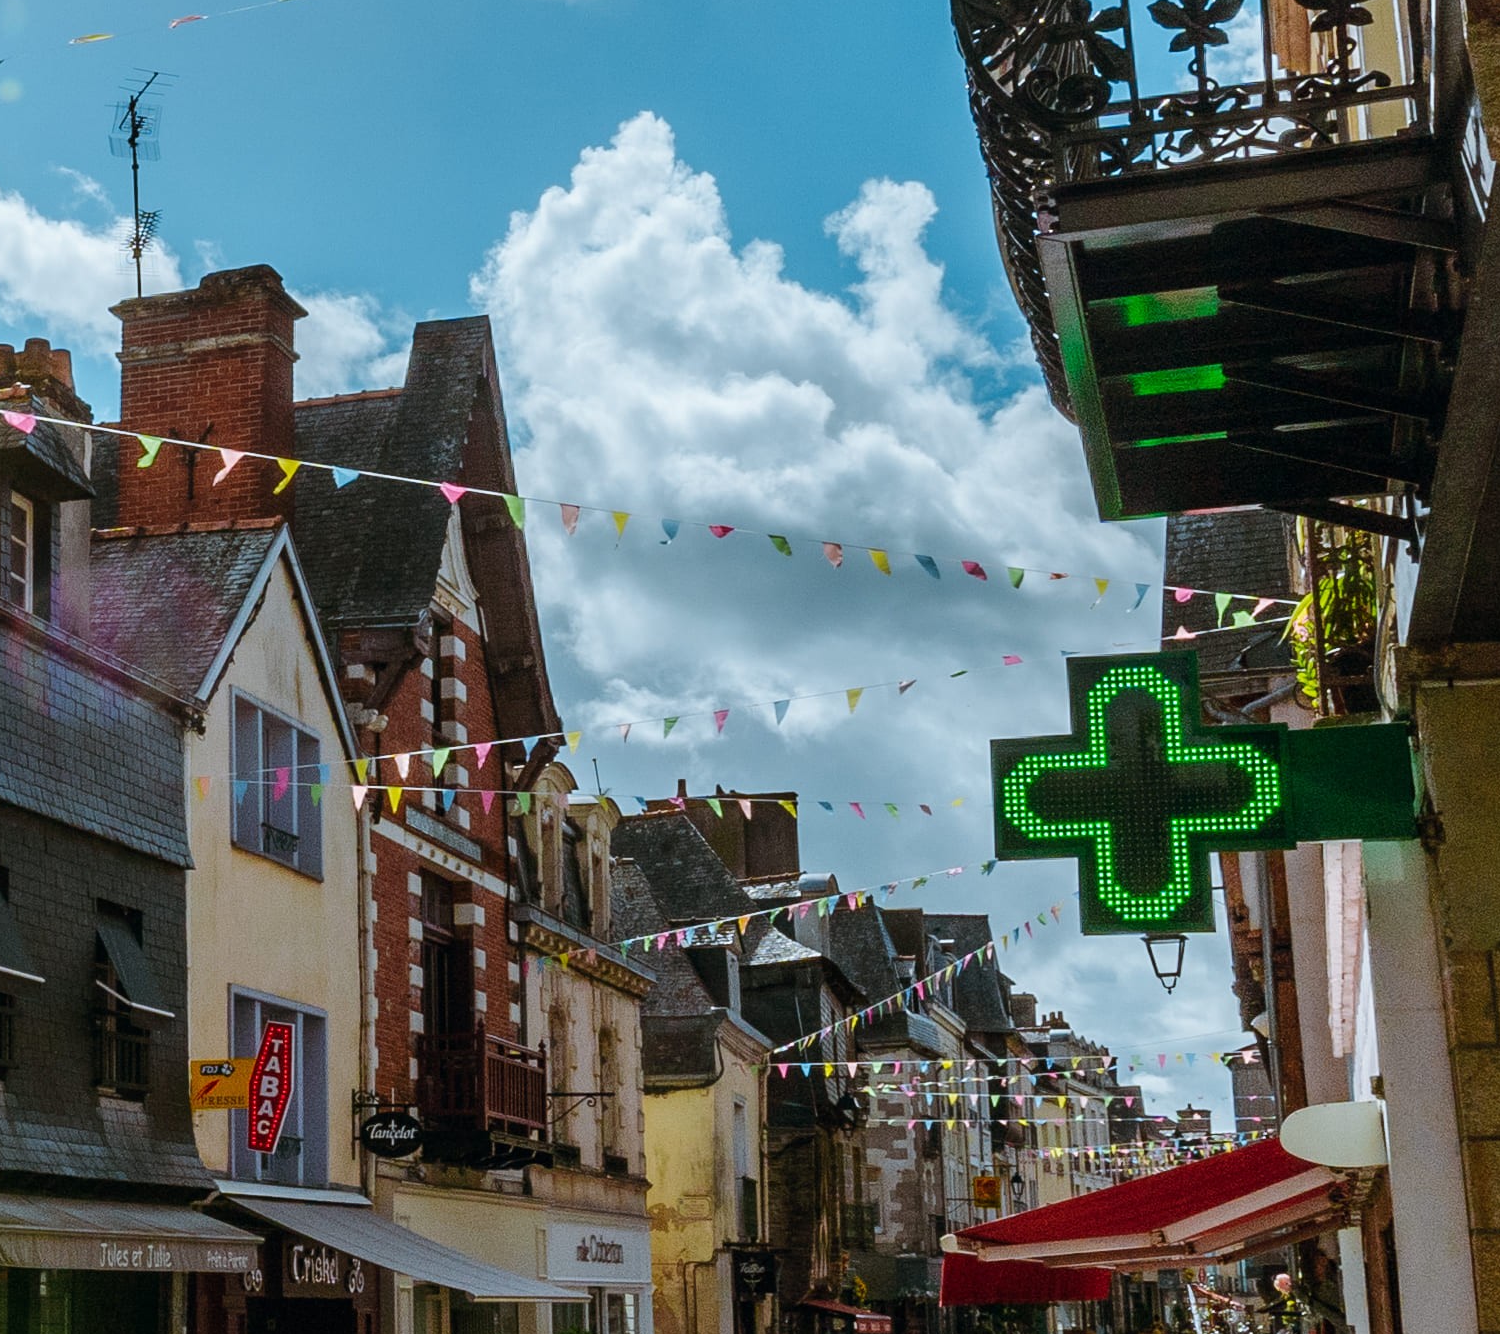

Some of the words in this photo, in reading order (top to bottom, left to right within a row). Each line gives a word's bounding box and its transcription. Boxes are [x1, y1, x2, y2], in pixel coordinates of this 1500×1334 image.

[201, 1065, 219, 1075] FDJ
[256, 1038, 284, 1136] TABAC
[201, 1095, 246, 1106] PRESSE
[100, 1242, 129, 1268] Jules
[132, 1248, 143, 1267] et
[147, 1244, 172, 1268] Julie
